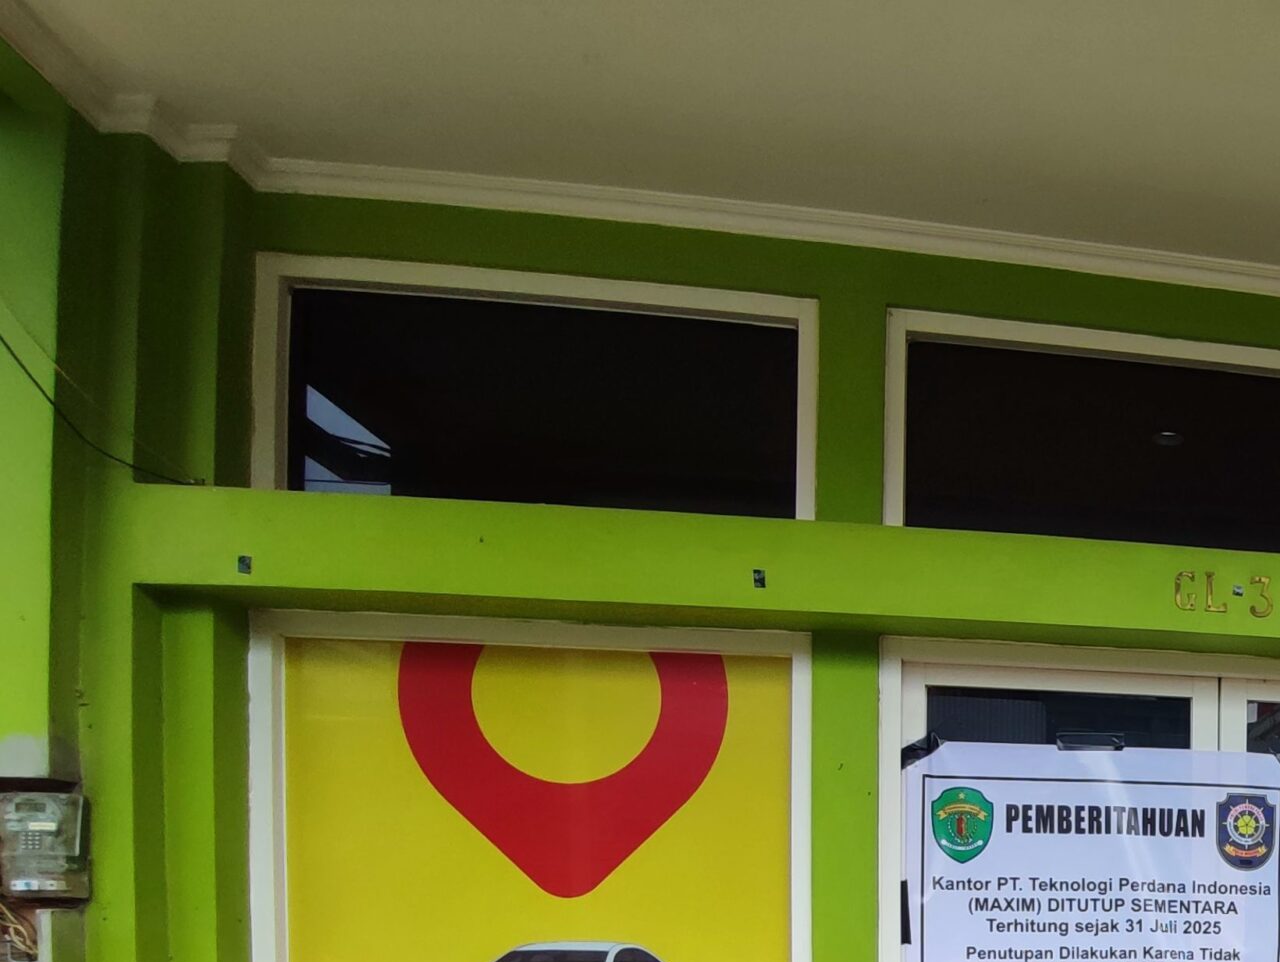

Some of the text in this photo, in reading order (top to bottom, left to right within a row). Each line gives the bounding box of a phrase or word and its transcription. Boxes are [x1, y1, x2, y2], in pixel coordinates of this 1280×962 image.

[1005, 803, 1206, 838] PEMBERITAHUAN
[932, 876, 1271, 896] Kantor PT. Teknologi Perdana Indonesia
[968, 897, 1239, 916] (MAXIM) DITUTUP SEMENTARA
[985, 918, 1222, 937] Terhitung sejak 31 Juli 2025
[966, 945, 1241, 962] Penutupan Dilakukan Karena Tidak
